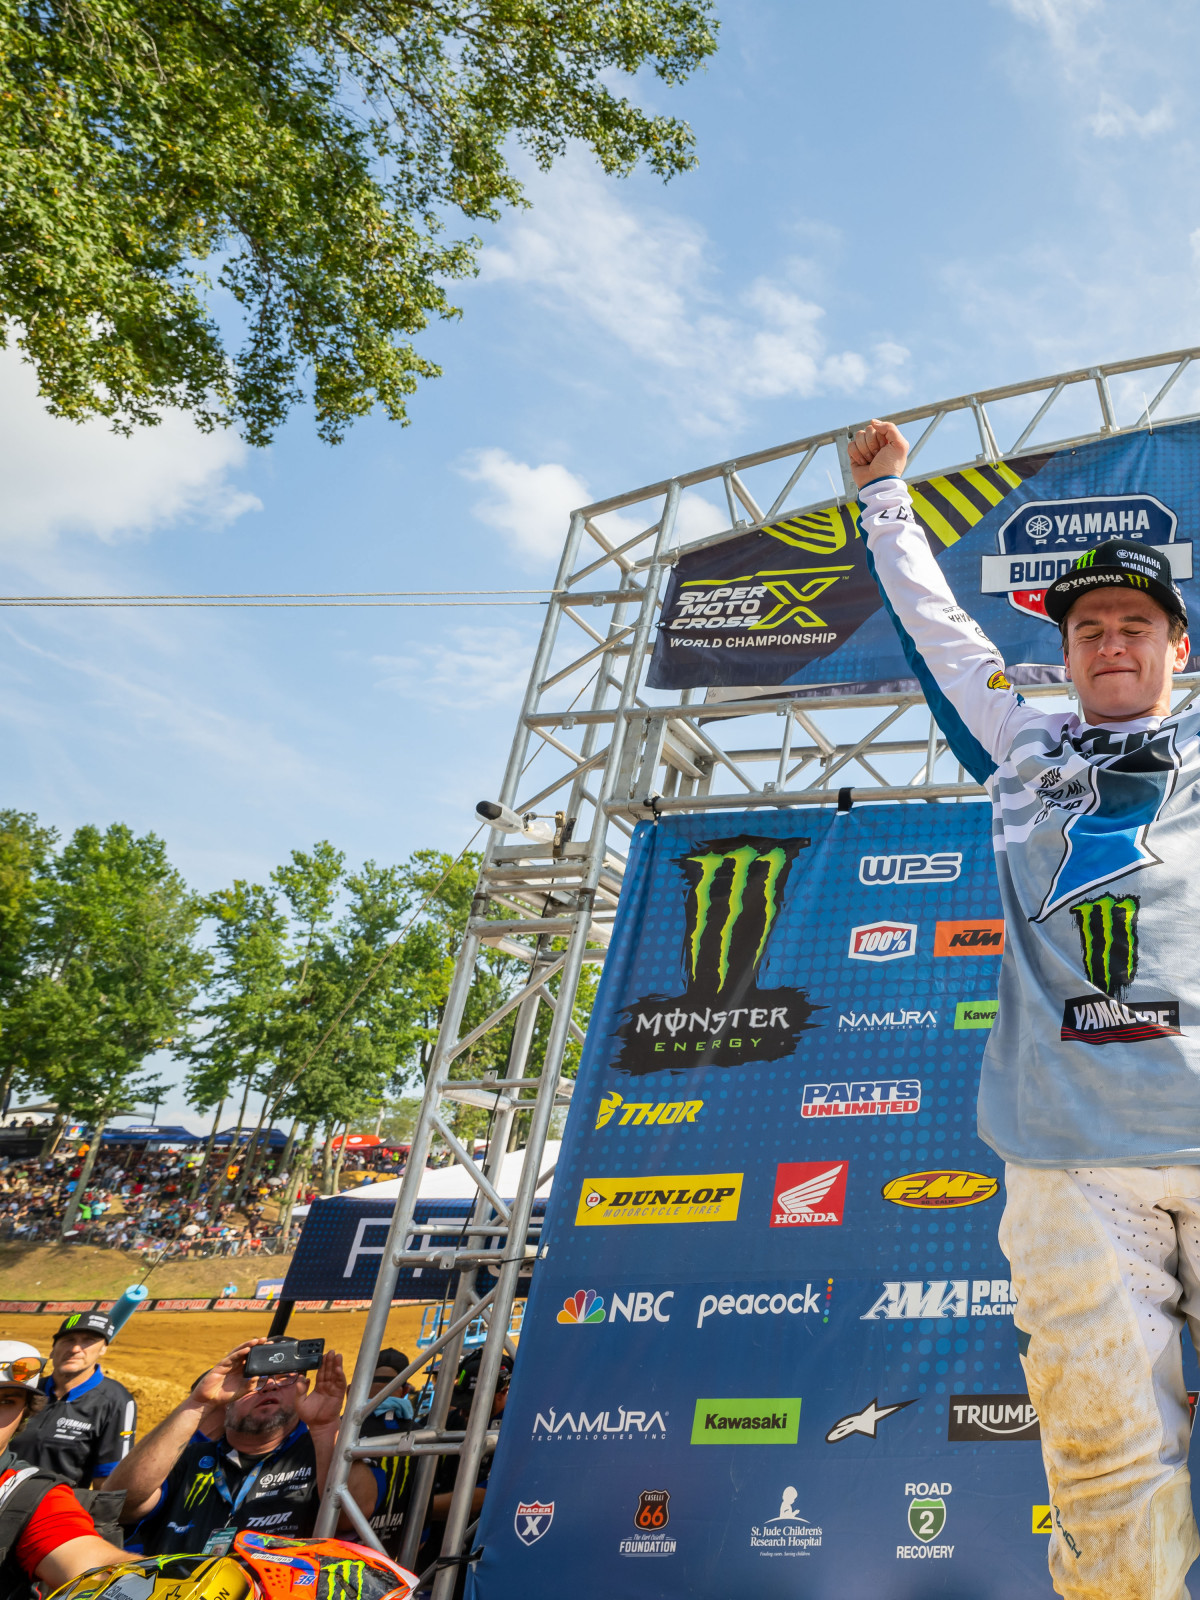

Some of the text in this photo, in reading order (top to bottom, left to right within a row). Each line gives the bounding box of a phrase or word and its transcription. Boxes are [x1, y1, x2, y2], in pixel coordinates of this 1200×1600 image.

[1054, 509, 1150, 536] YAMAHA
[1035, 532, 1143, 545] RACING
[1128, 551, 1161, 570] YAMAHA
[1010, 558, 1079, 584] BUDD
[1069, 574, 1124, 588] YAMAHA
[676, 586, 768, 606] SUPER
[679, 600, 761, 617] MOTO
[669, 615, 761, 630] CROSS
[670, 632, 837, 648] WORLD CHAMPIONSHIP
[860, 853, 962, 884] WPS
[858, 930, 907, 953] 100%
[948, 929, 1002, 948] KTM
[635, 1005, 790, 1037] MONSTER
[838, 1008, 937, 1028] NAMURA
[963, 1010, 998, 1020] Kawa
[654, 1038, 762, 1052] ENERGY
[803, 1081, 920, 1105] PARTS
[621, 1100, 703, 1126] THOR
[803, 1100, 919, 1117] UNLIMITED
[883, 1174, 998, 1200] FMF
[608, 1187, 736, 1207] DUNLOP
[602, 1205, 722, 1219] MOTORCYCLE TIRES
[774, 1212, 839, 1225] HONDA
[608, 1291, 675, 1323] NBC
[697, 1283, 821, 1329] peacock
[859, 1280, 969, 1320] AMA
[971, 1304, 1016, 1316] RACIN
[532, 1405, 666, 1433] NAMURA
[704, 1413, 787, 1430] Kawasaki
[953, 1404, 1037, 1430] TRIUMP
[644, 1494, 665, 1502] CASELLI
[904, 1483, 952, 1496] ROAD
[246, 1511, 293, 1528] THOR
[640, 1505, 664, 1526] 66
[919, 1511, 935, 1534] 2
[522, 1516, 543, 1536] X
[751, 1525, 823, 1537] St. Jude Children's
[619, 1541, 677, 1553] FOUNDATION
[750, 1536, 822, 1549] Research Hospital
[896, 1545, 955, 1559] RECOVERY
